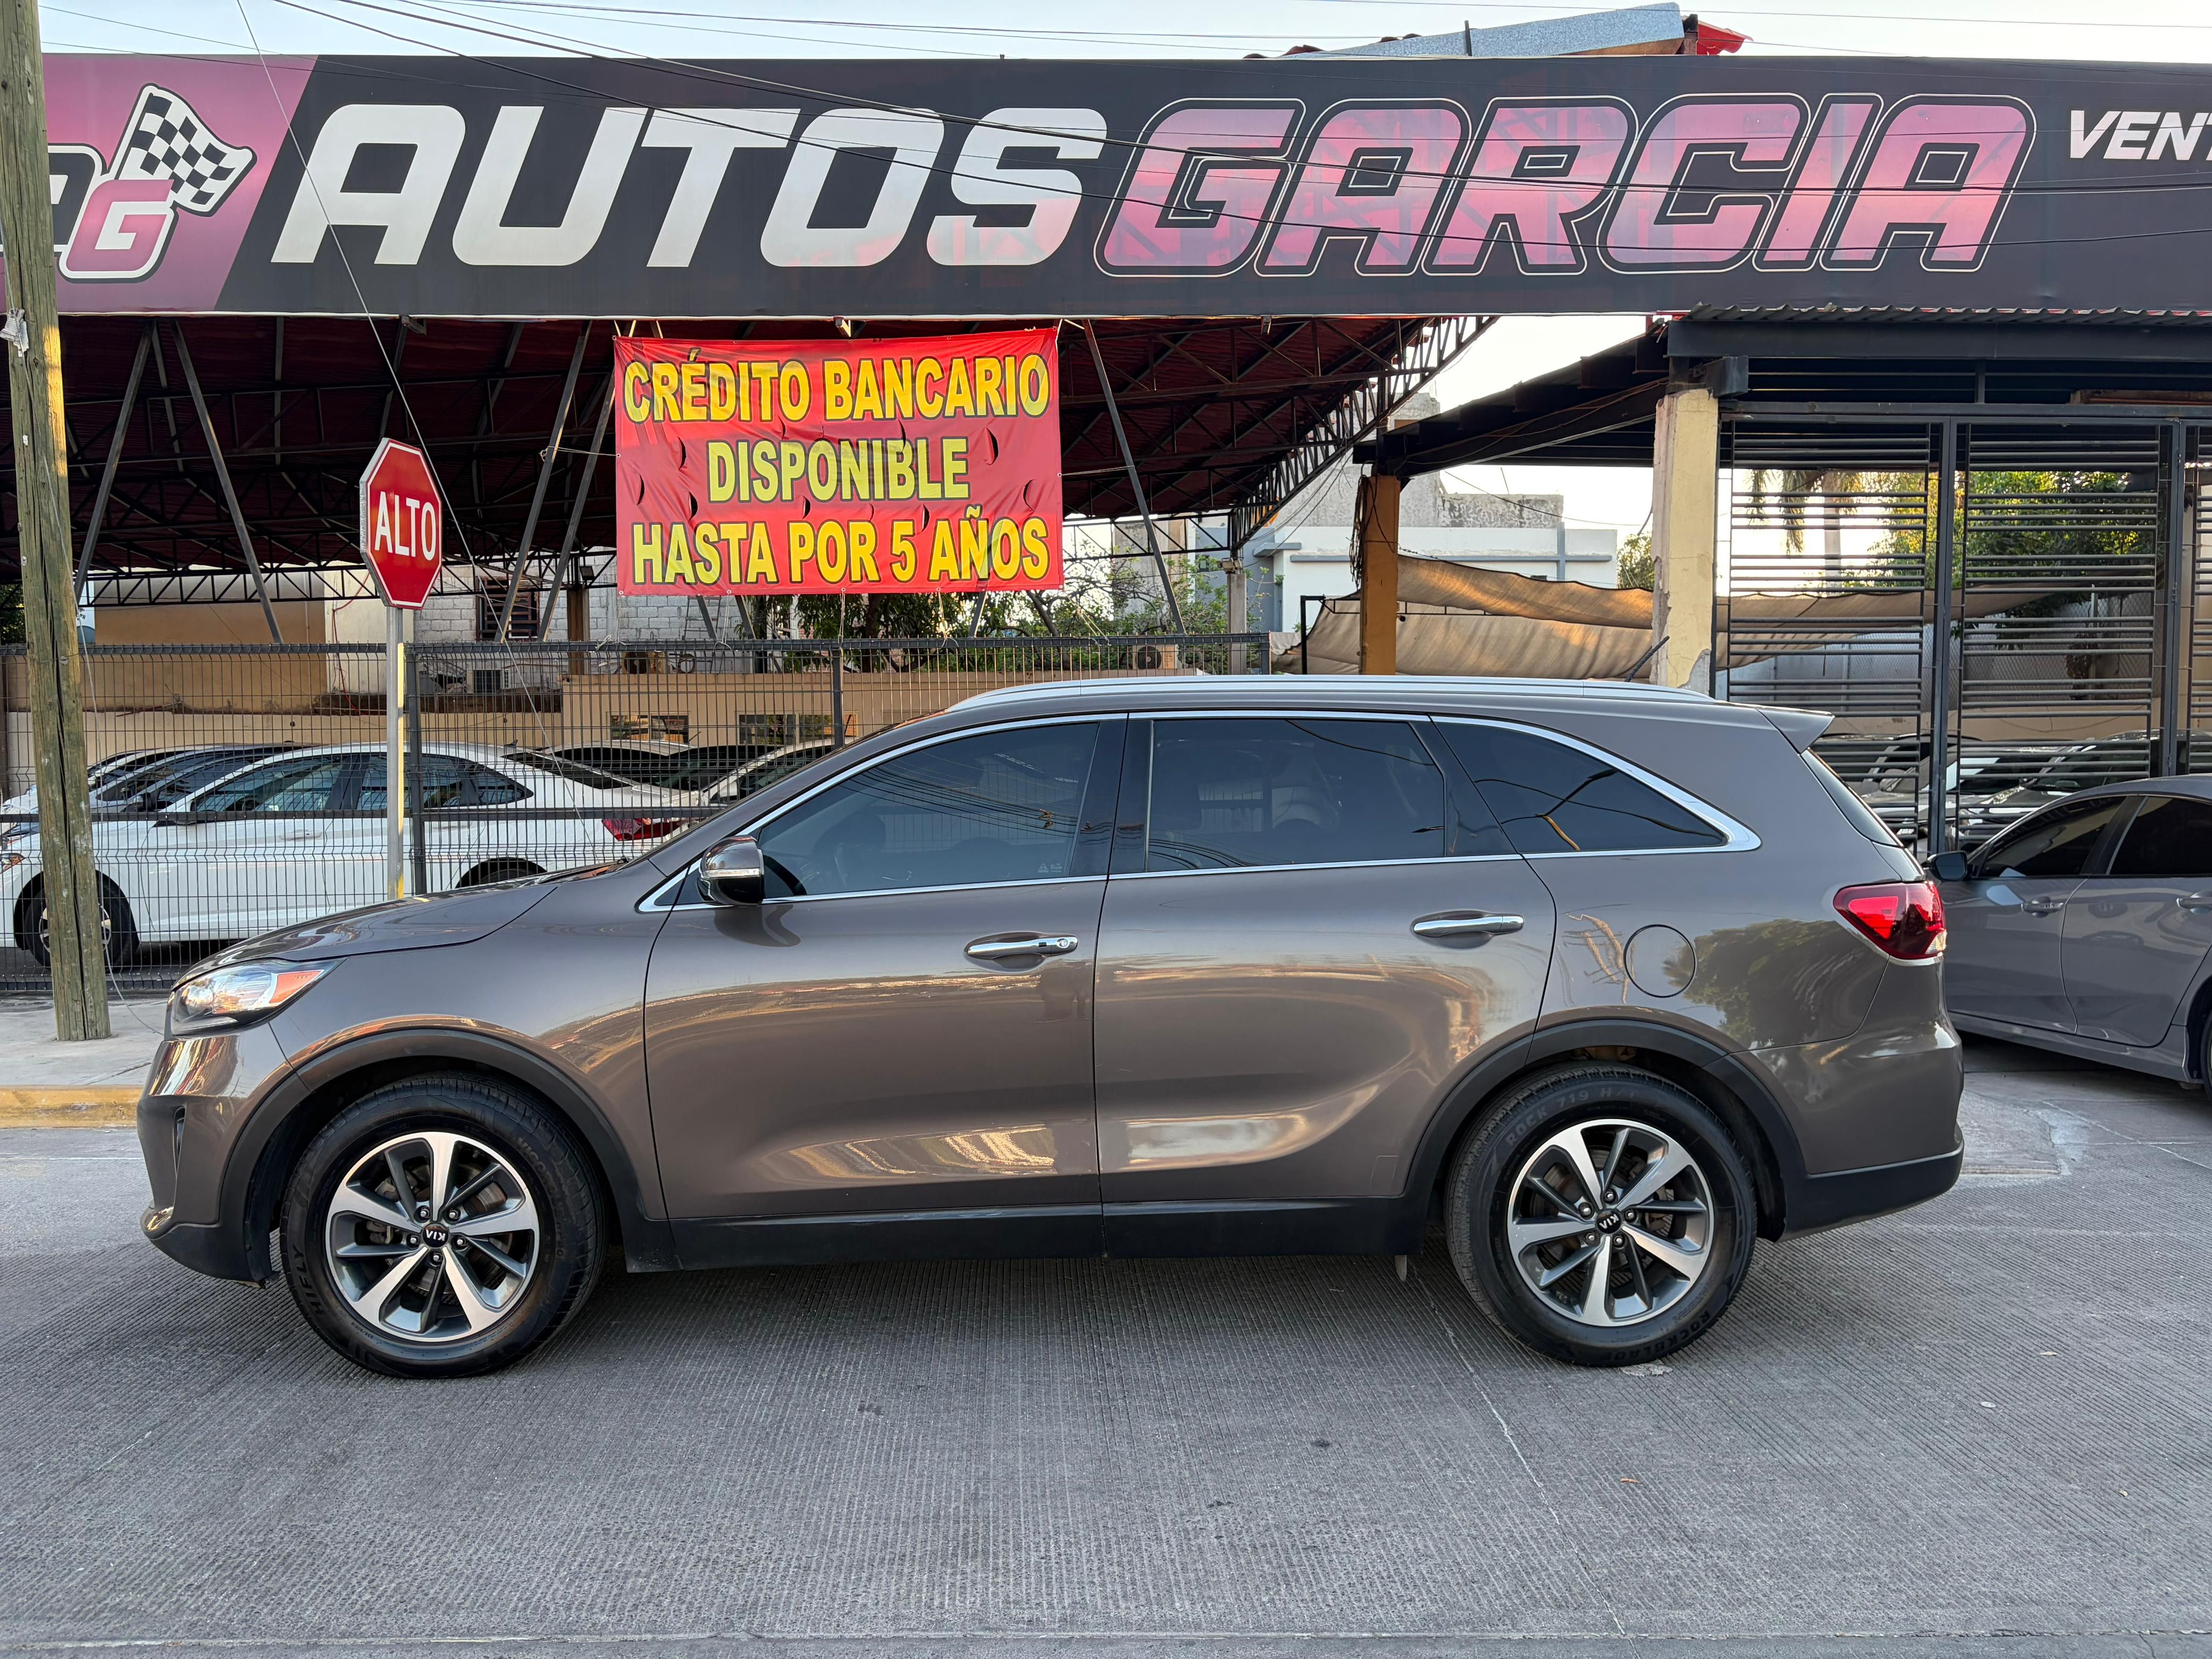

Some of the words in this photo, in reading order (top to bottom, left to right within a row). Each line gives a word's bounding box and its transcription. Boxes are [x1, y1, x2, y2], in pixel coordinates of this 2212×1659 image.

[2069, 110, 2212, 161] VEN
[271, 104, 1107, 267] AUTOS
[1094, 93, 2037, 276] GARCIA
[624, 347, 811, 423] CRÉDITO
[823, 353, 1050, 420] BANCARIO
[707, 437, 970, 503] DISPONIBLE
[374, 491, 436, 560] ALTO
[632, 521, 779, 584] HASTA
[787, 520, 881, 582] POR
[891, 519, 917, 582] 5
[928, 504, 1050, 581] AÑOS
[1505, 1107, 1547, 1146] ROCK
[1557, 1091, 1589, 1108] 719
[426, 1229, 446, 1242] KIA
[1599, 1213, 1619, 1229] KIA
[293, 1243, 325, 1315] HIFLY
